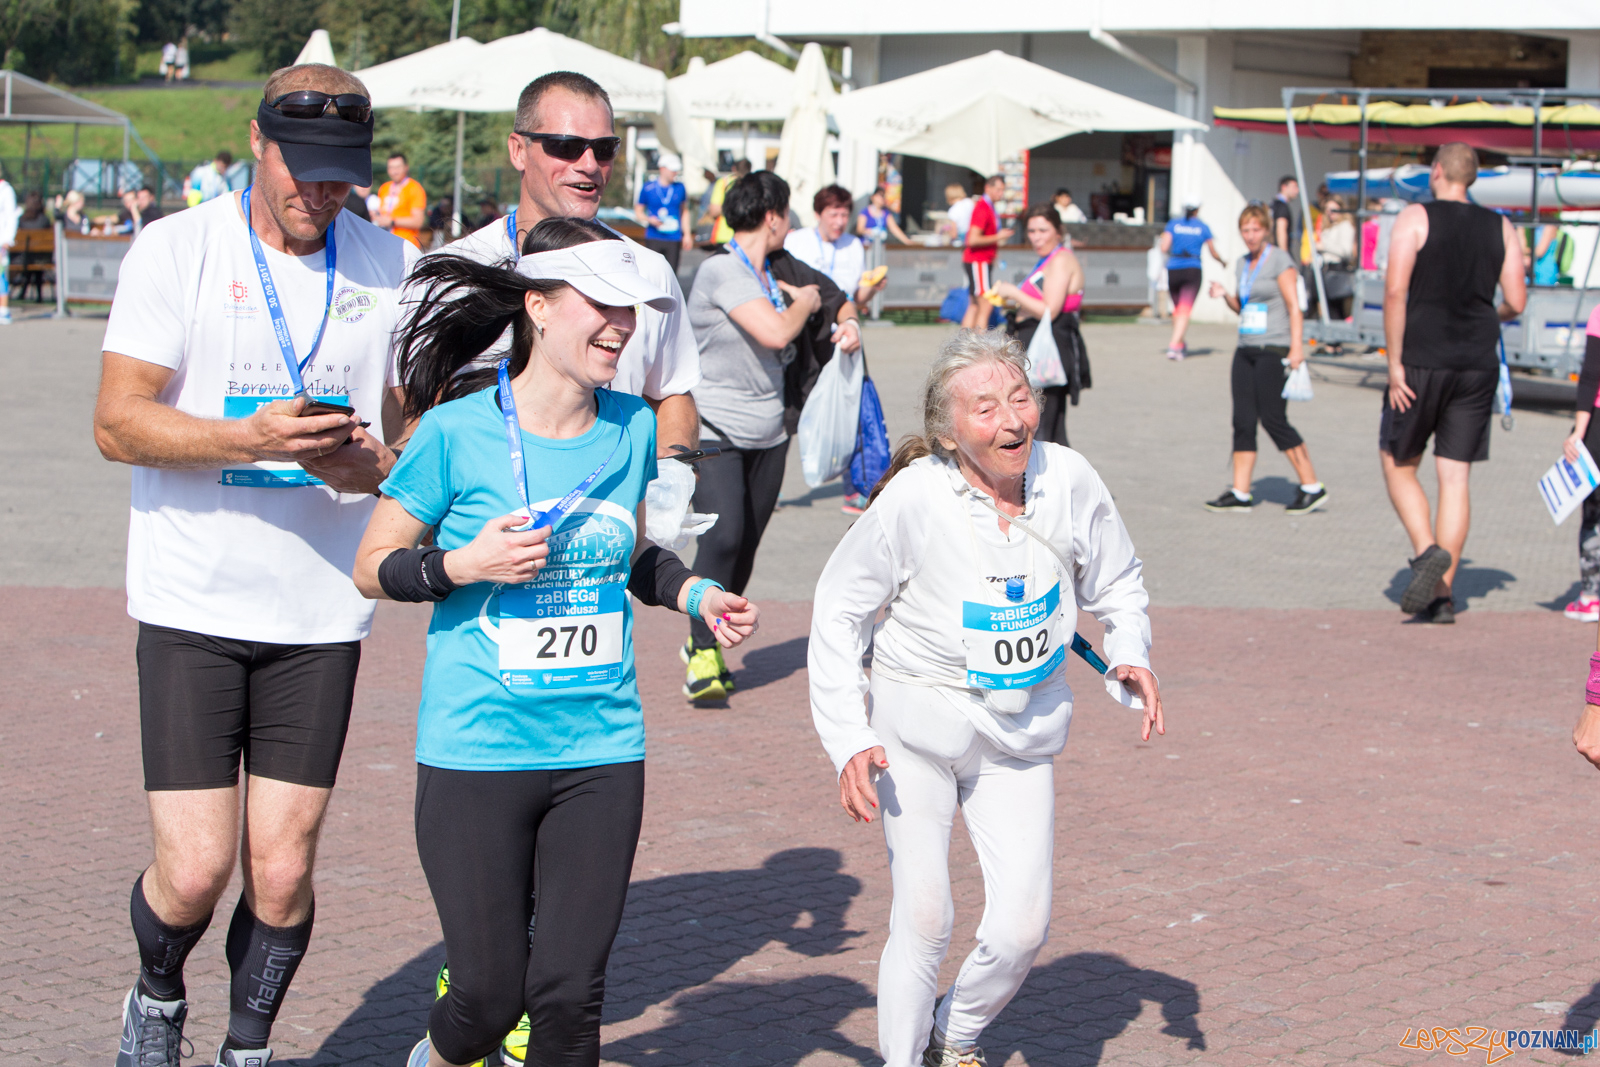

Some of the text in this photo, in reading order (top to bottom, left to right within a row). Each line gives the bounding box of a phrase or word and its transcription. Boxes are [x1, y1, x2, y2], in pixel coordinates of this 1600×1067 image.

[258, 263, 278, 308] 30.09.2017
[336, 298, 356, 316] BOROWO
[346, 312, 363, 322] TEAM
[229, 362, 350, 372] SOŁETWO
[226, 380, 290, 396] Borowo
[536, 588, 599, 604] zaBIEGaj
[536, 605, 598, 616] o FUNdusze
[990, 598, 1046, 621] zaBIEGaj
[1000, 612, 1048, 630] FUNdusze
[536, 624, 598, 658] 270
[994, 628, 1049, 666] 002
[246, 942, 302, 1014] kalenji
